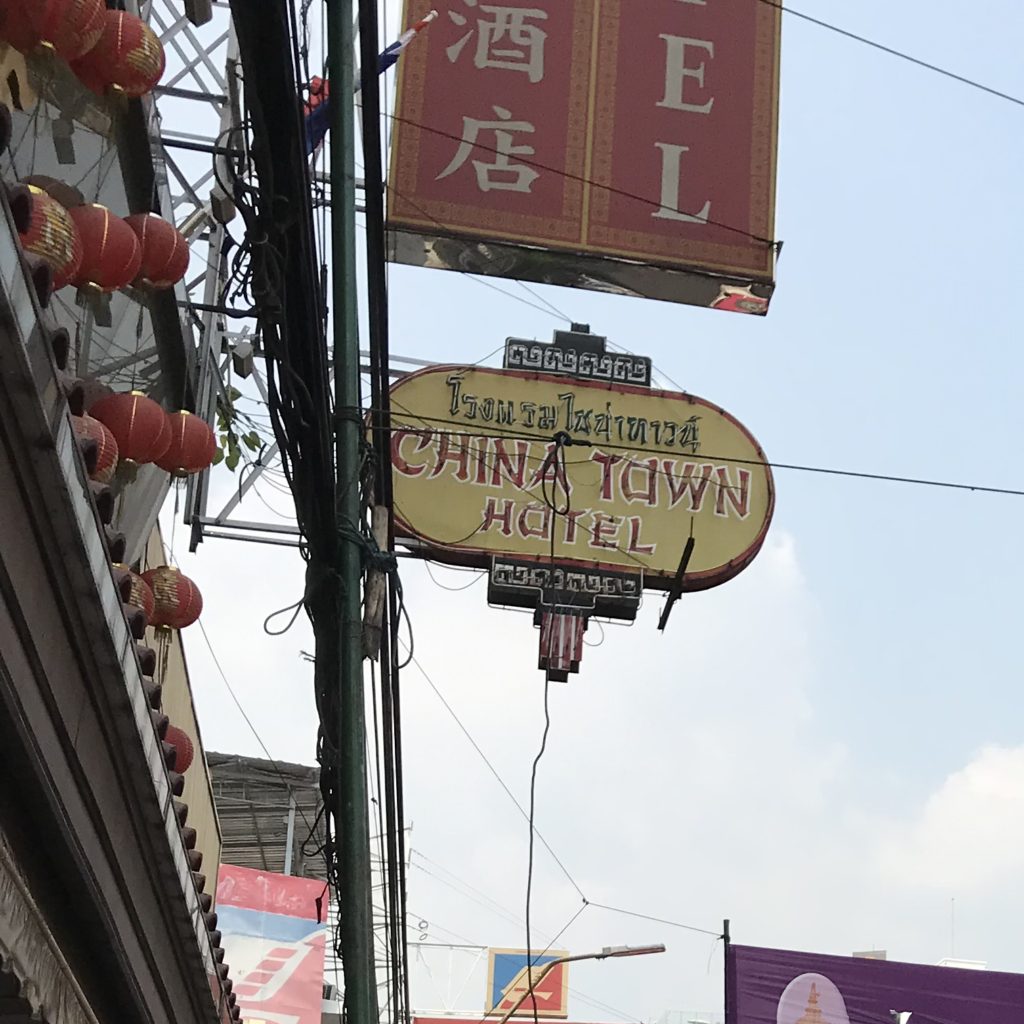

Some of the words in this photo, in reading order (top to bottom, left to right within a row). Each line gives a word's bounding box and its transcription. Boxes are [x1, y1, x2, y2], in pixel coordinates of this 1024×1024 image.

[435, 0, 548, 193] 酒店
[651, 0, 714, 225] EL
[390, 425, 573, 496] CHINA
[590, 448, 752, 520] TOWN
[480, 498, 656, 556] HOTEL
